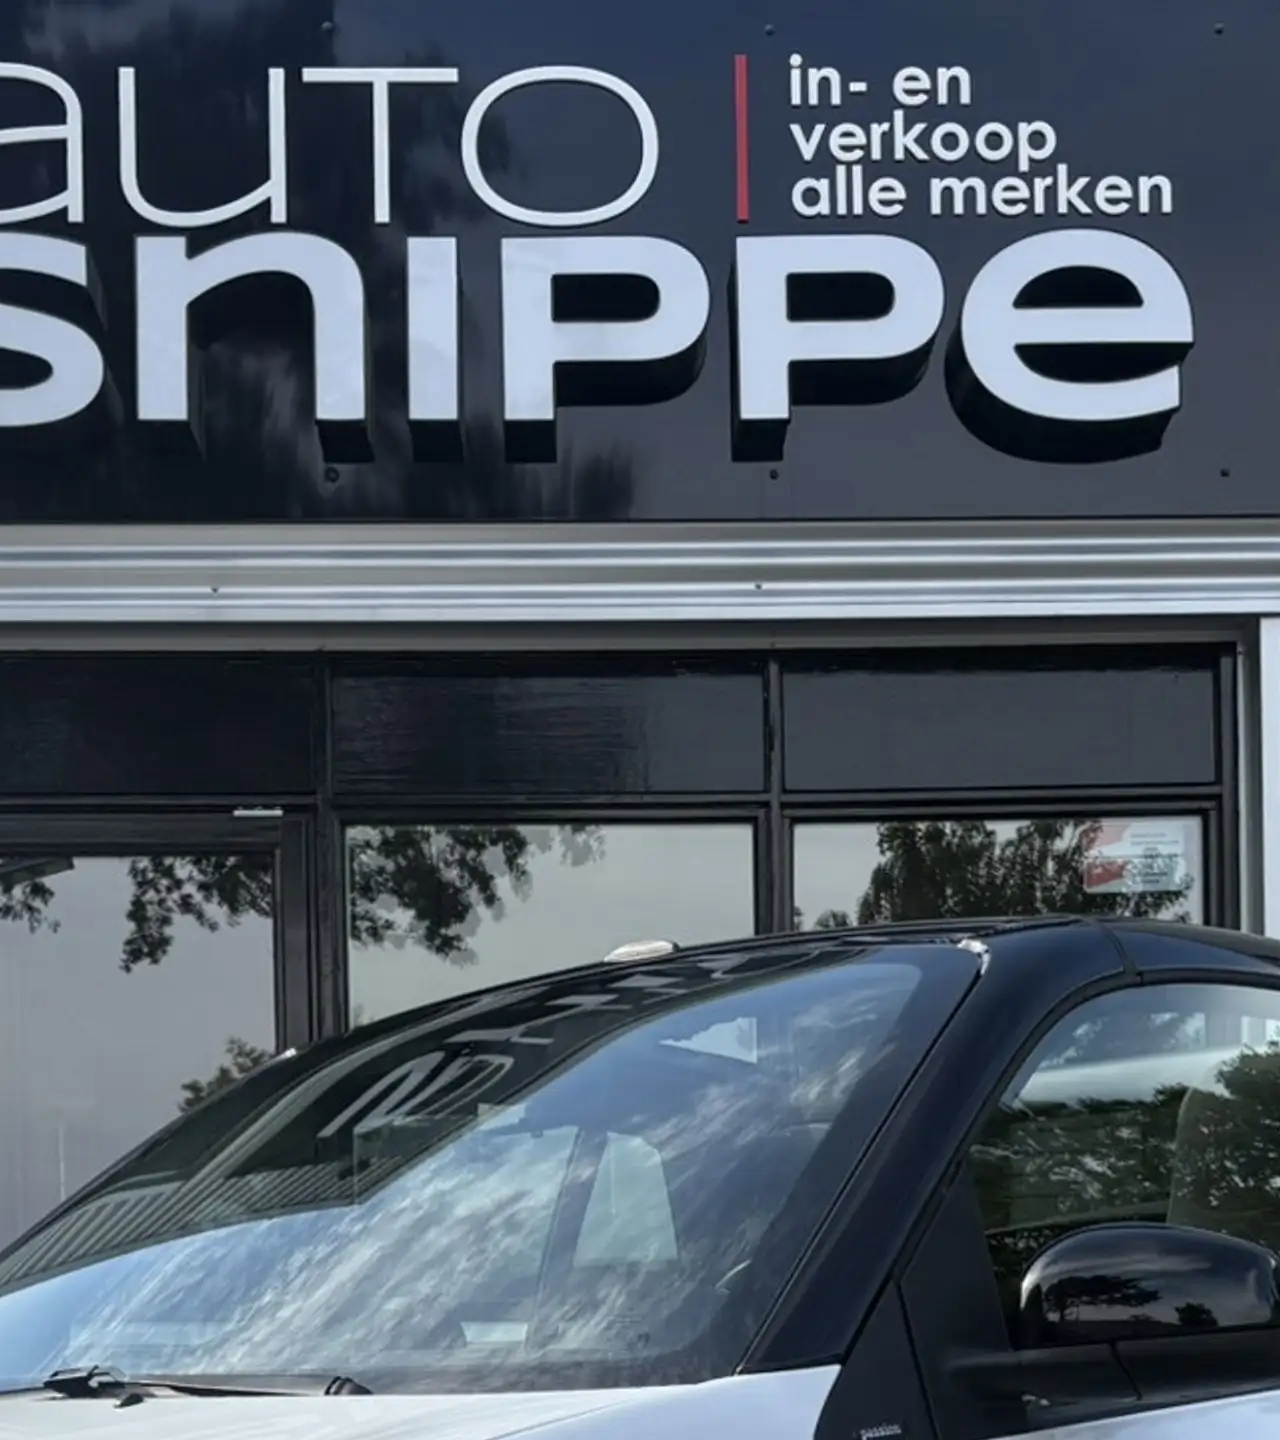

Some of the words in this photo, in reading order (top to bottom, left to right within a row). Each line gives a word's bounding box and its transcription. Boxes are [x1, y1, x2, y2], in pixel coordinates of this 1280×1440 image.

[789, 54, 867, 106] in-
[892, 65, 971, 106] en
[790, 110, 1056, 172] verkoop
[791, 165, 907, 217] alle
[930, 164, 1173, 217] merken
